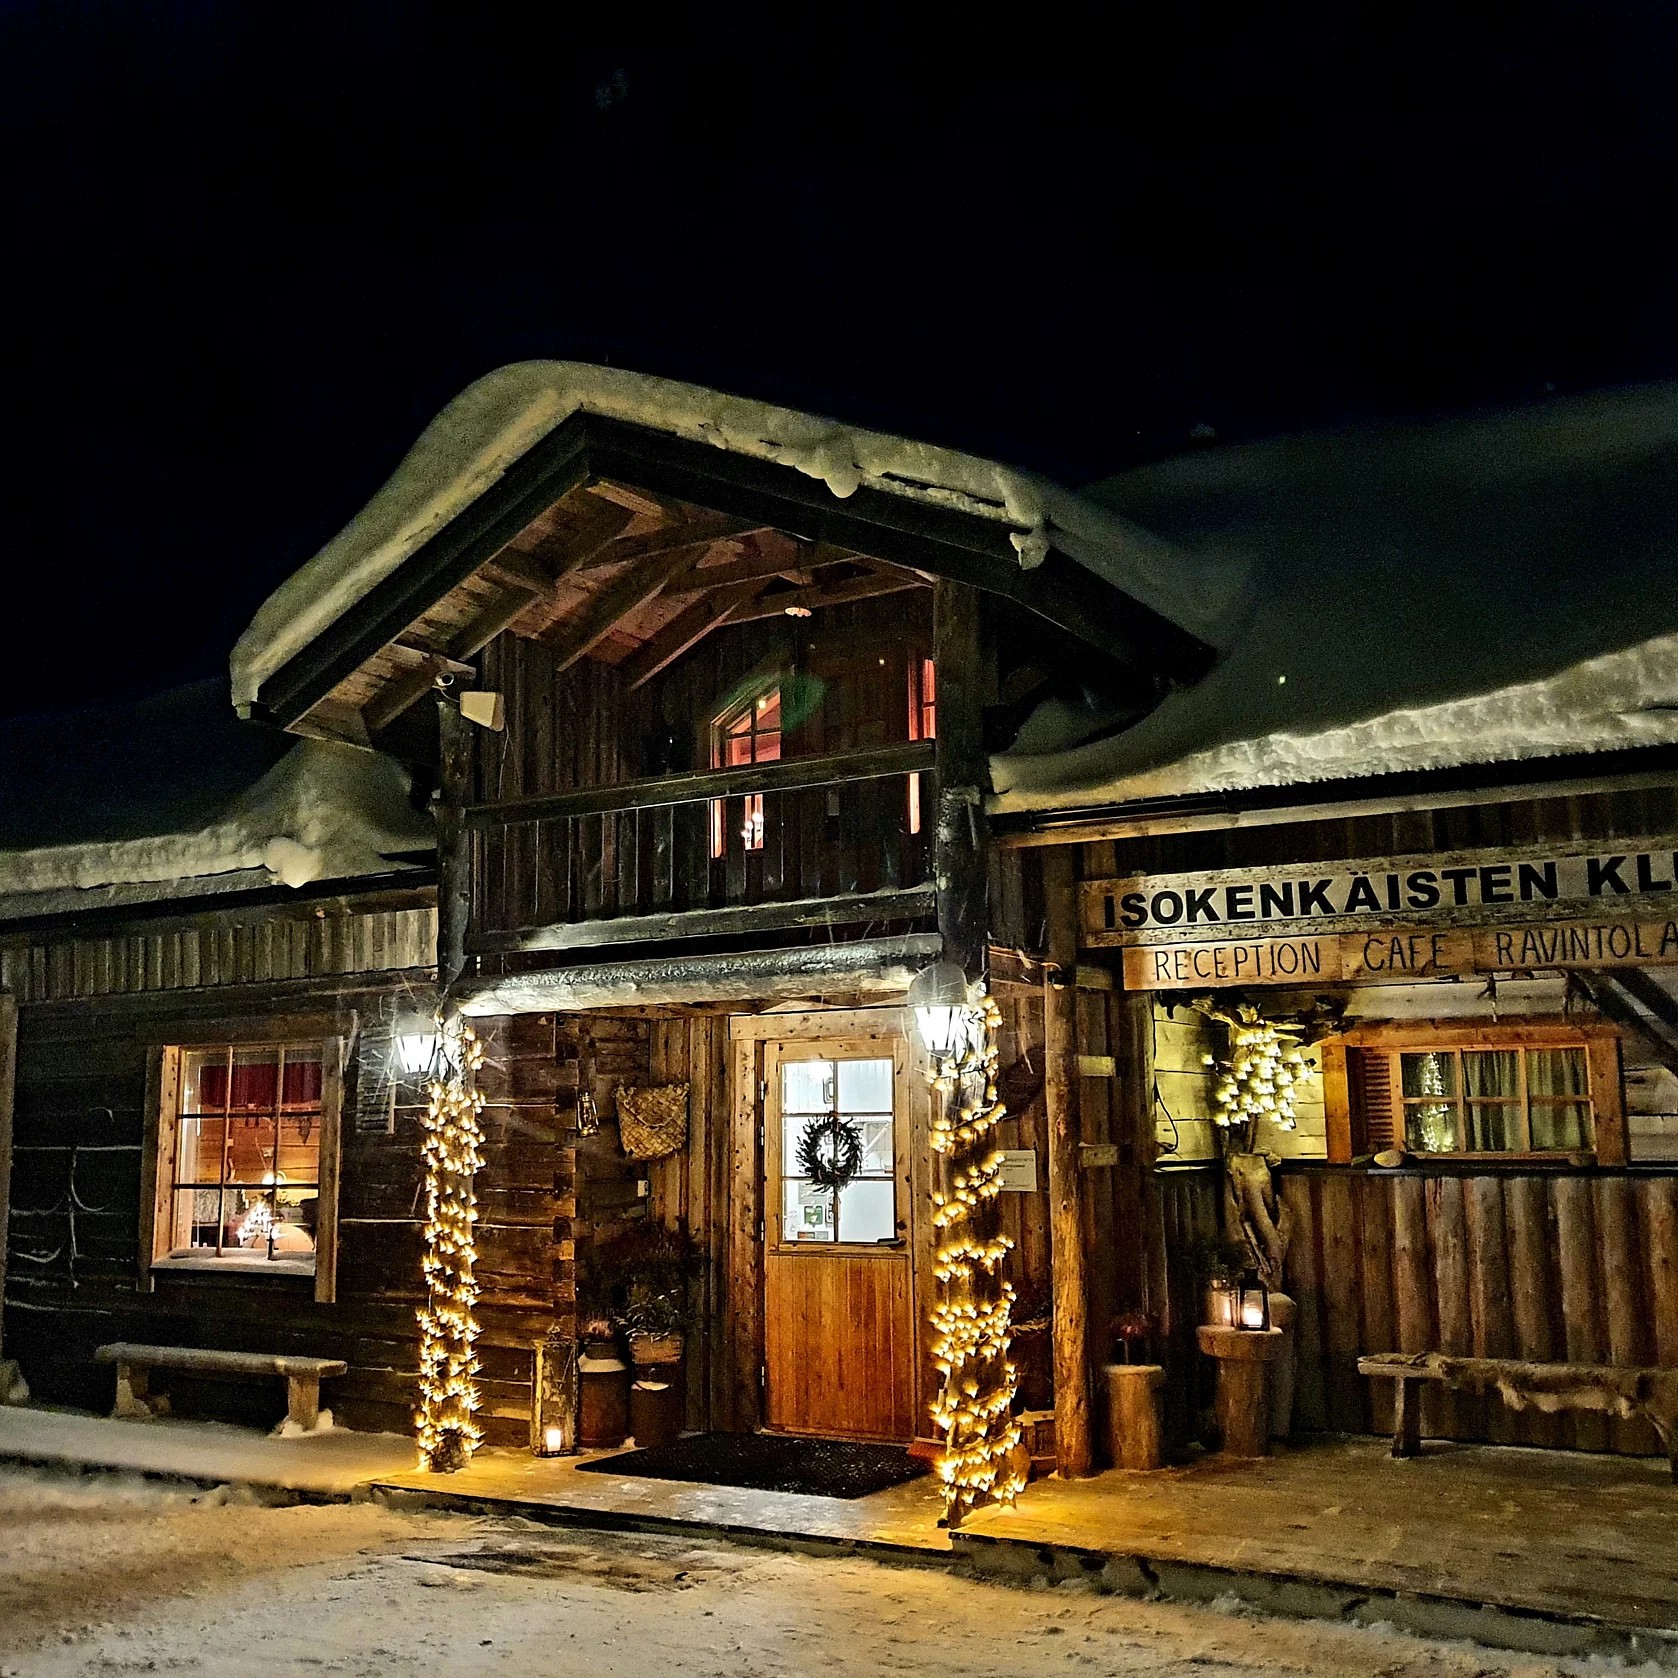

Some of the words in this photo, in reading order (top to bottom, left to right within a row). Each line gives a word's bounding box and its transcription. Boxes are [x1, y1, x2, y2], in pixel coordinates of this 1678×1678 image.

[1104, 861, 1558, 929] ISOKENKÄISTEN
[1155, 942, 1321, 981] RECEPTION
[1363, 933, 1450, 972] CAFE
[1496, 921, 1678, 965] RAVINTOLA
